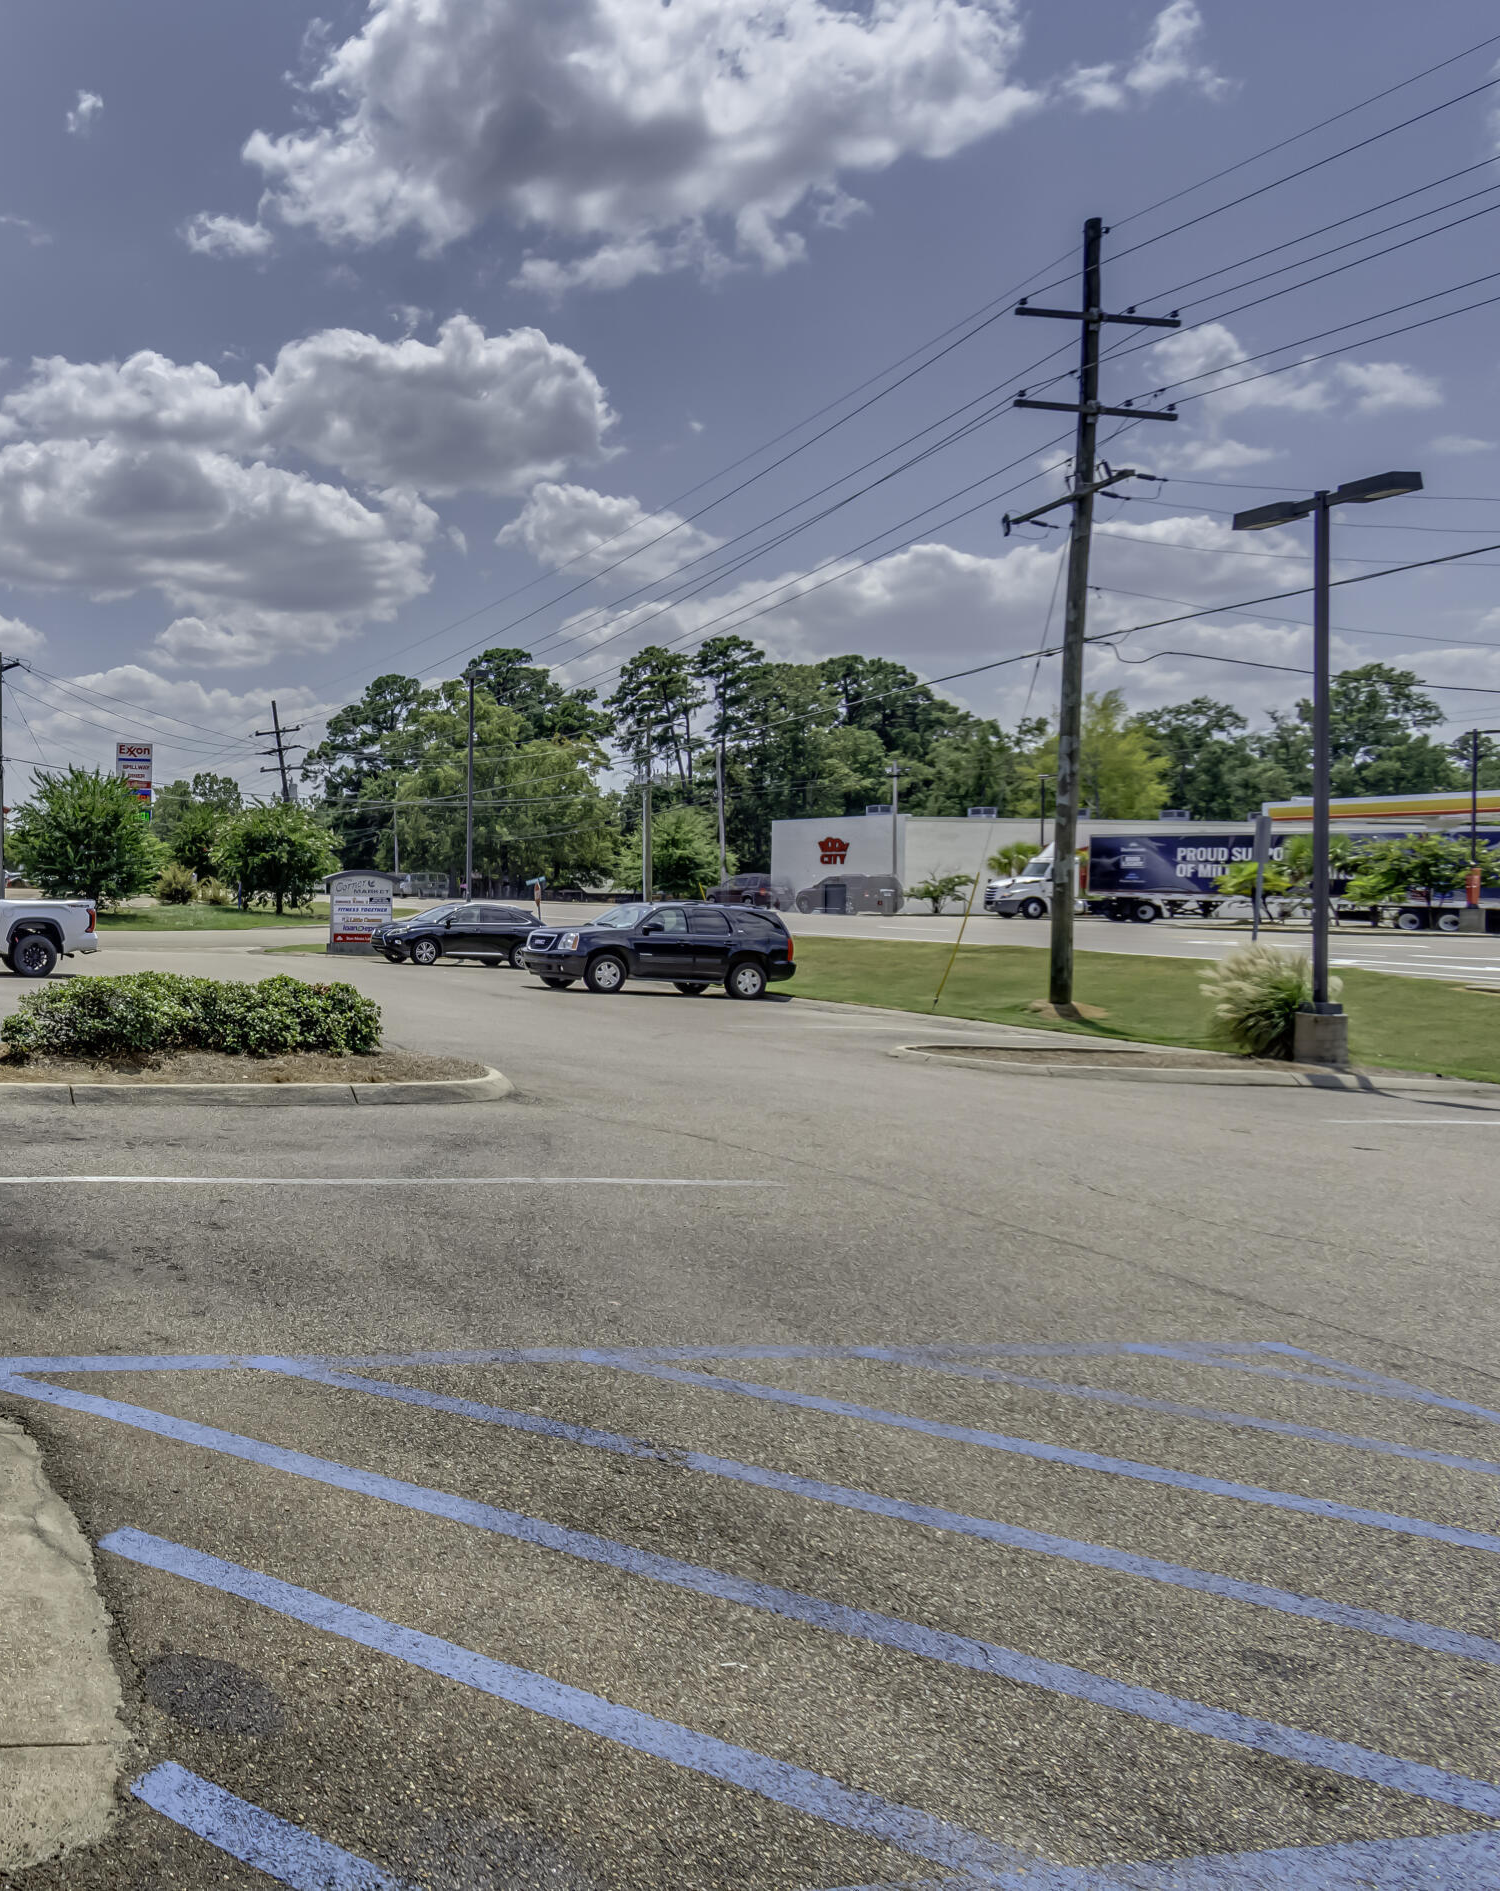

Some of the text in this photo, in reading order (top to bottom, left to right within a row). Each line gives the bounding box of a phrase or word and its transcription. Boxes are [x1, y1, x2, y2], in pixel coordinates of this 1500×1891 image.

[119, 744, 150, 757] Exxon
[820, 853, 847, 864] CITY
[1177, 847, 1228, 861] PROUD
[1176, 863, 1196, 877] OF
